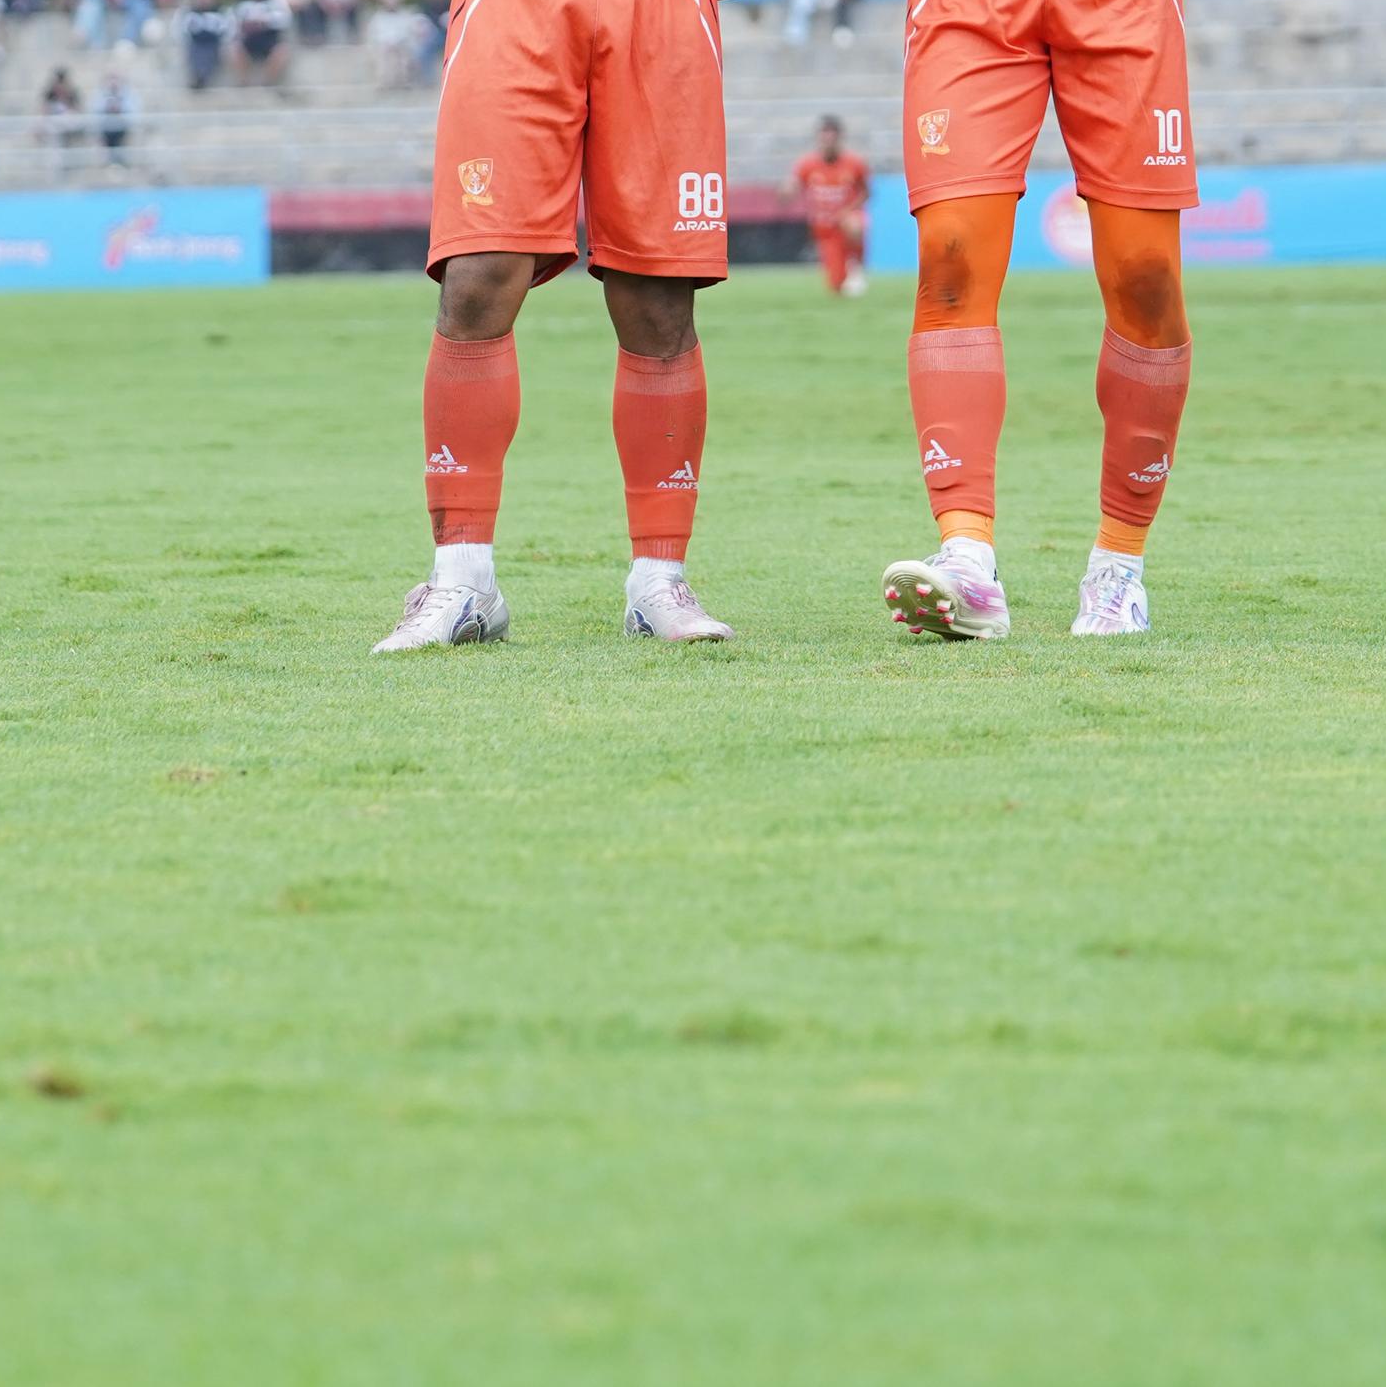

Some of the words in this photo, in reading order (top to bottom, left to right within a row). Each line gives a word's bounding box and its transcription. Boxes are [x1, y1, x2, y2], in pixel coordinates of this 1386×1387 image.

[1154, 108, 1182, 153] 10
[1143, 156, 1187, 166] ARAFS
[678, 172, 723, 219] 88
[673, 220, 727, 232] ARAFS
[424, 465, 468, 474] RAFS
[923, 459, 962, 475] RAFS
